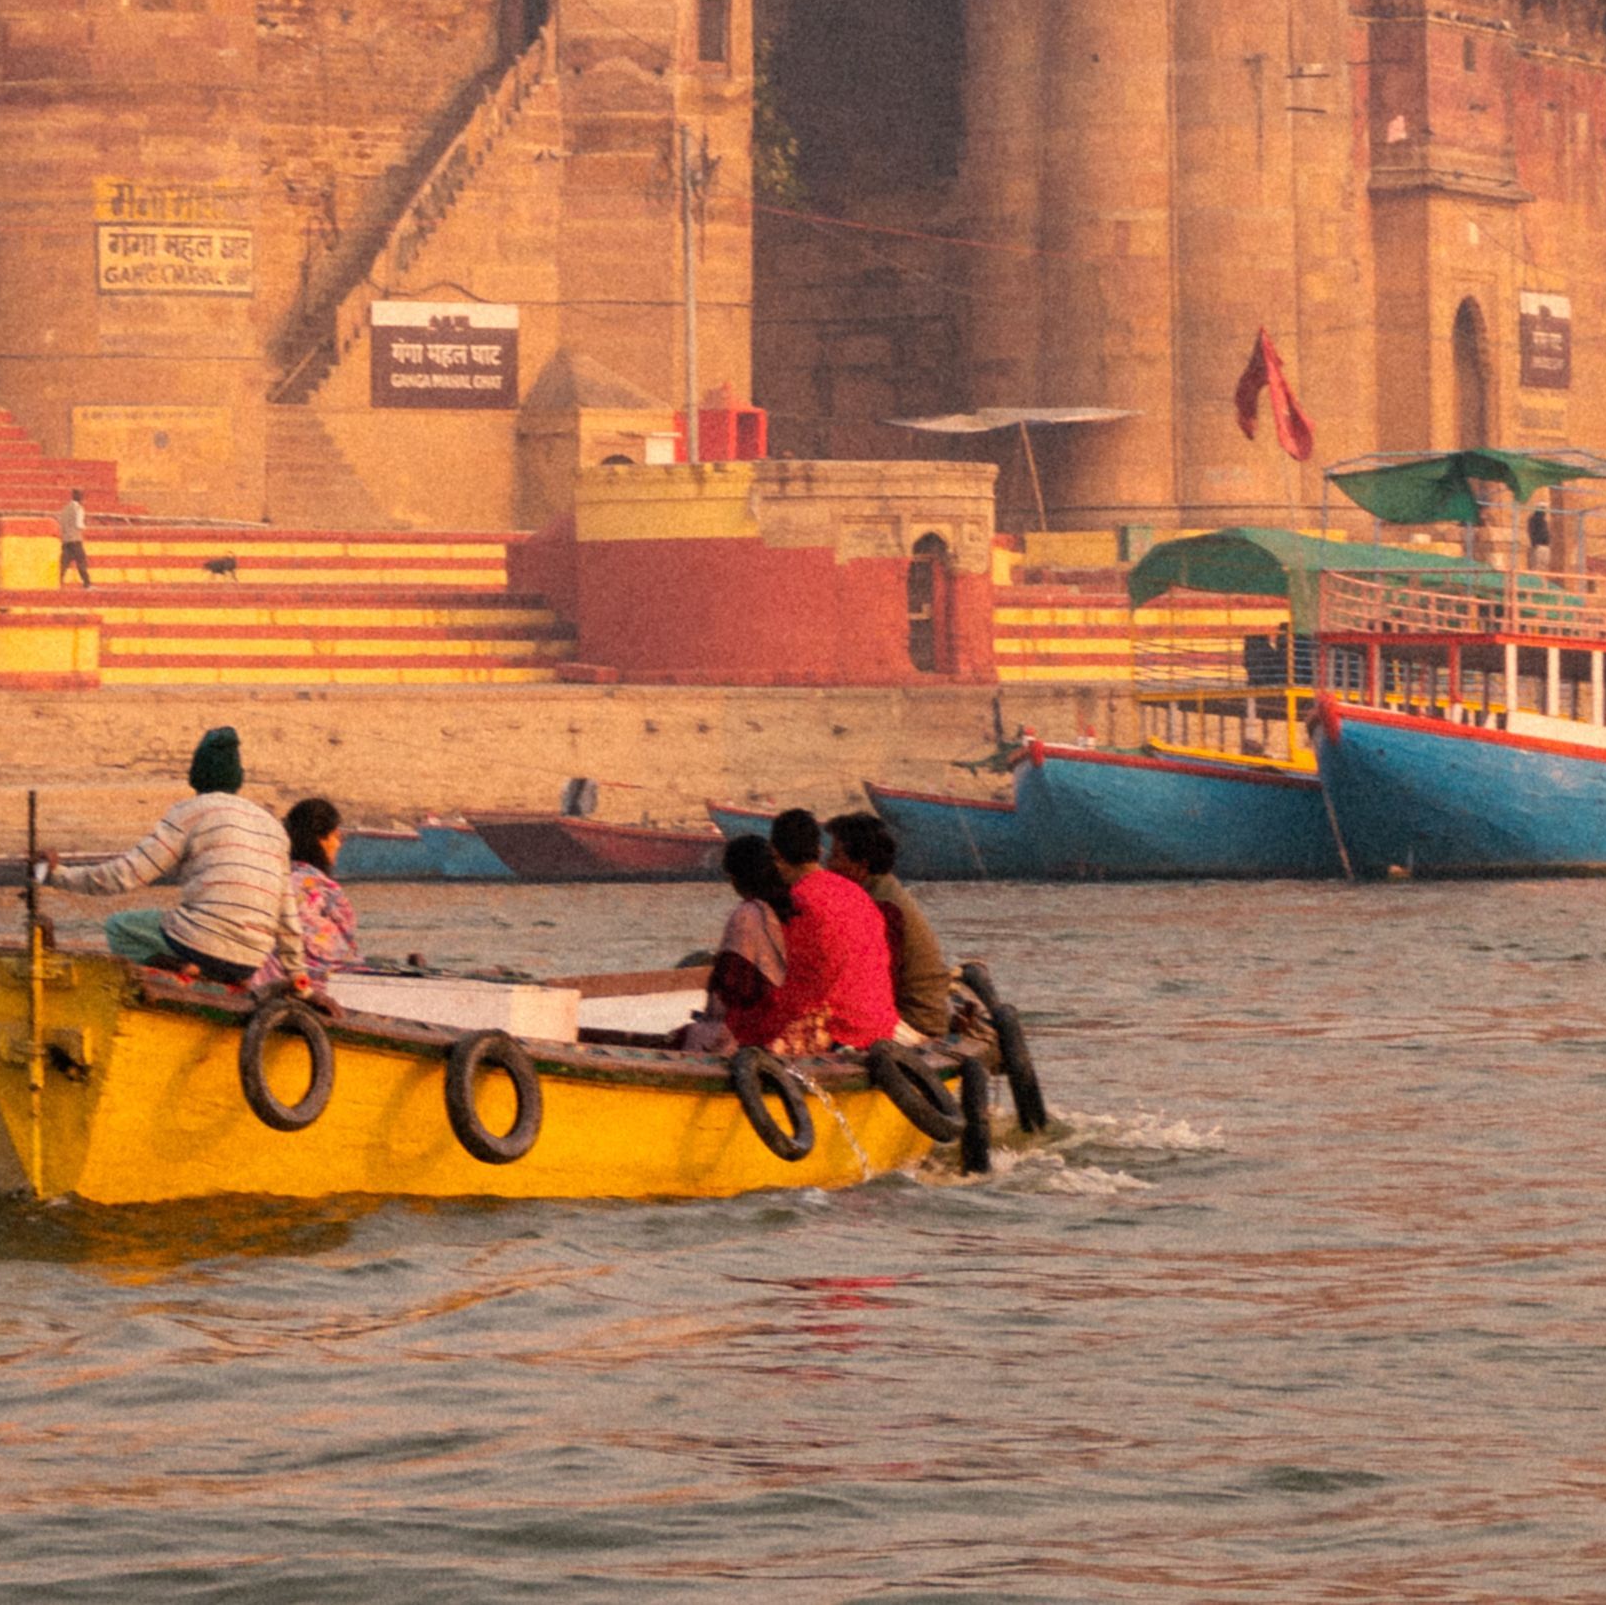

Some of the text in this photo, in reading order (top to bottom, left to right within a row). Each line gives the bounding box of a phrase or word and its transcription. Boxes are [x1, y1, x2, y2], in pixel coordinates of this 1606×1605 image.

[390, 337, 503, 369] गंगा महल घाट
